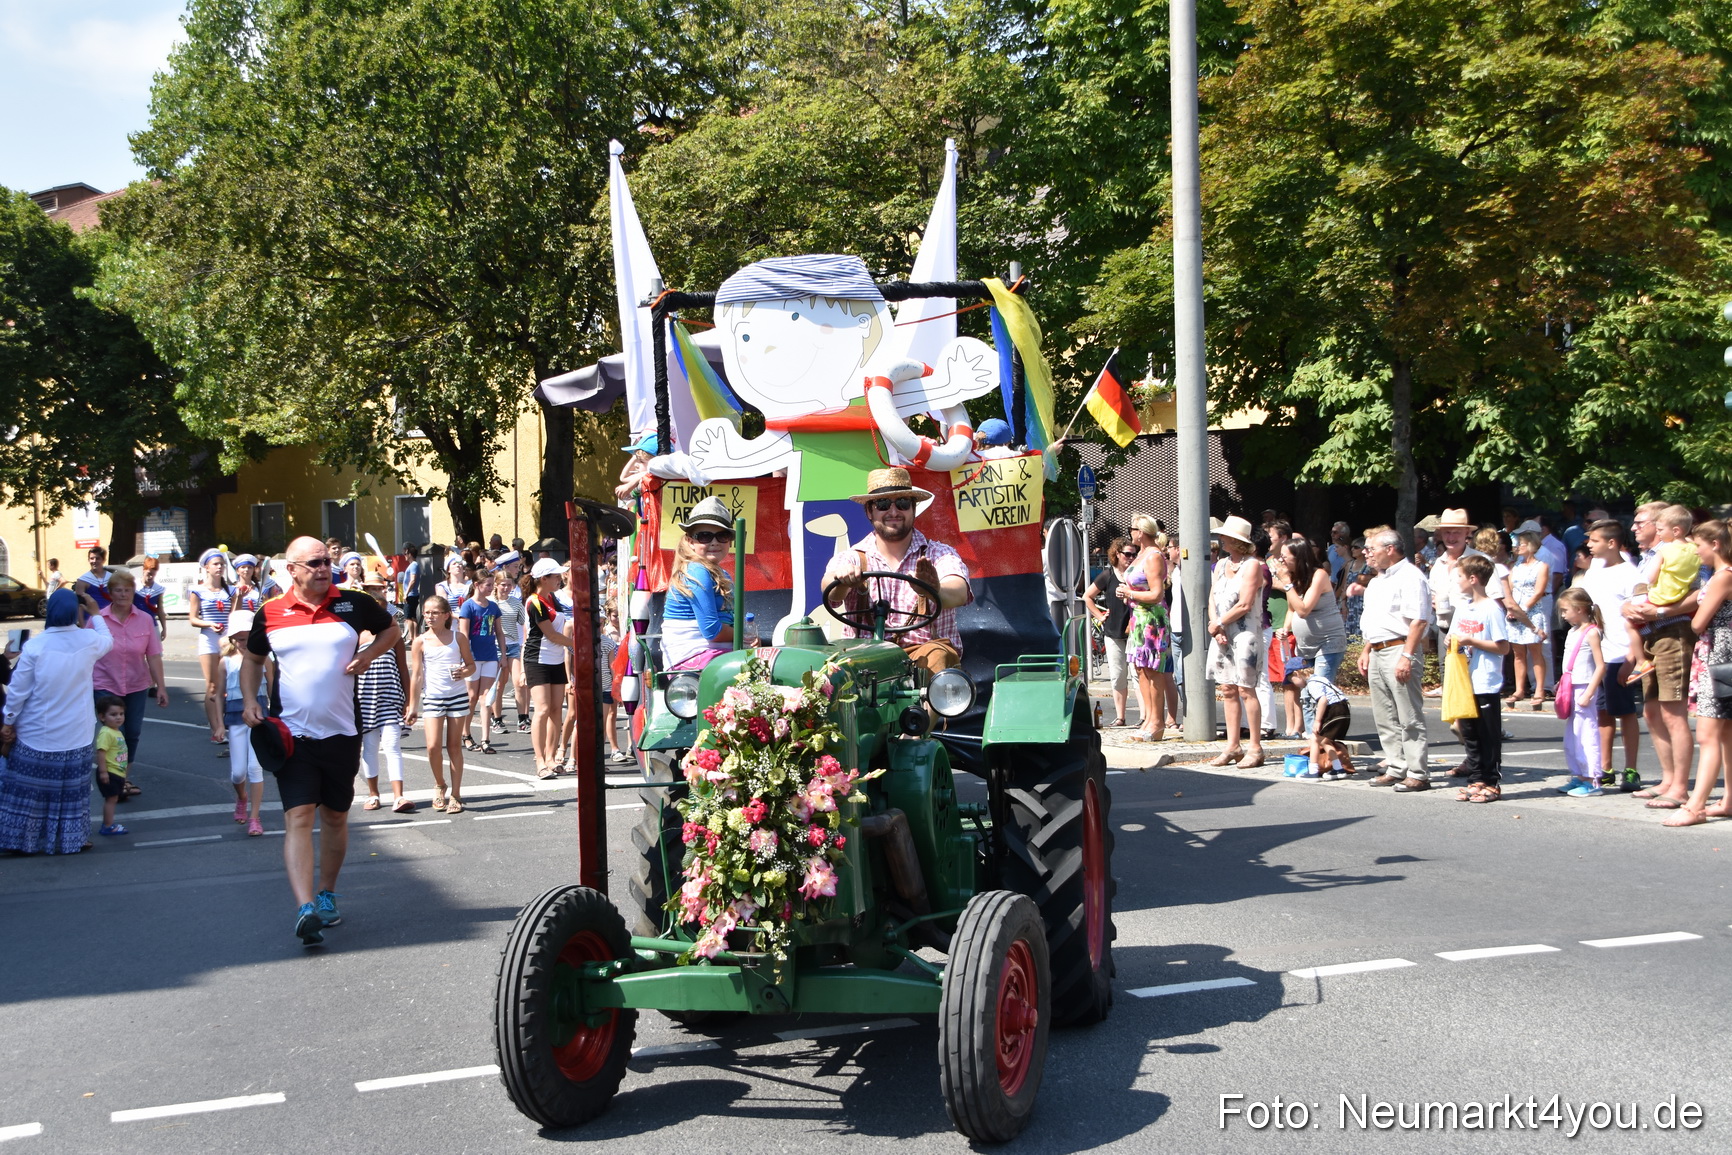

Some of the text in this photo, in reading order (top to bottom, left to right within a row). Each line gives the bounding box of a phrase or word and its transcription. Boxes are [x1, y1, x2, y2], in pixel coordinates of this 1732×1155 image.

[958, 463, 1003, 486] TURN
[1018, 458, 1032, 481] &
[667, 485, 713, 504] TURN
[731, 486, 745, 509] &
[958, 483, 1028, 510] ARTISTIK
[981, 504, 1031, 526] VEREIN
